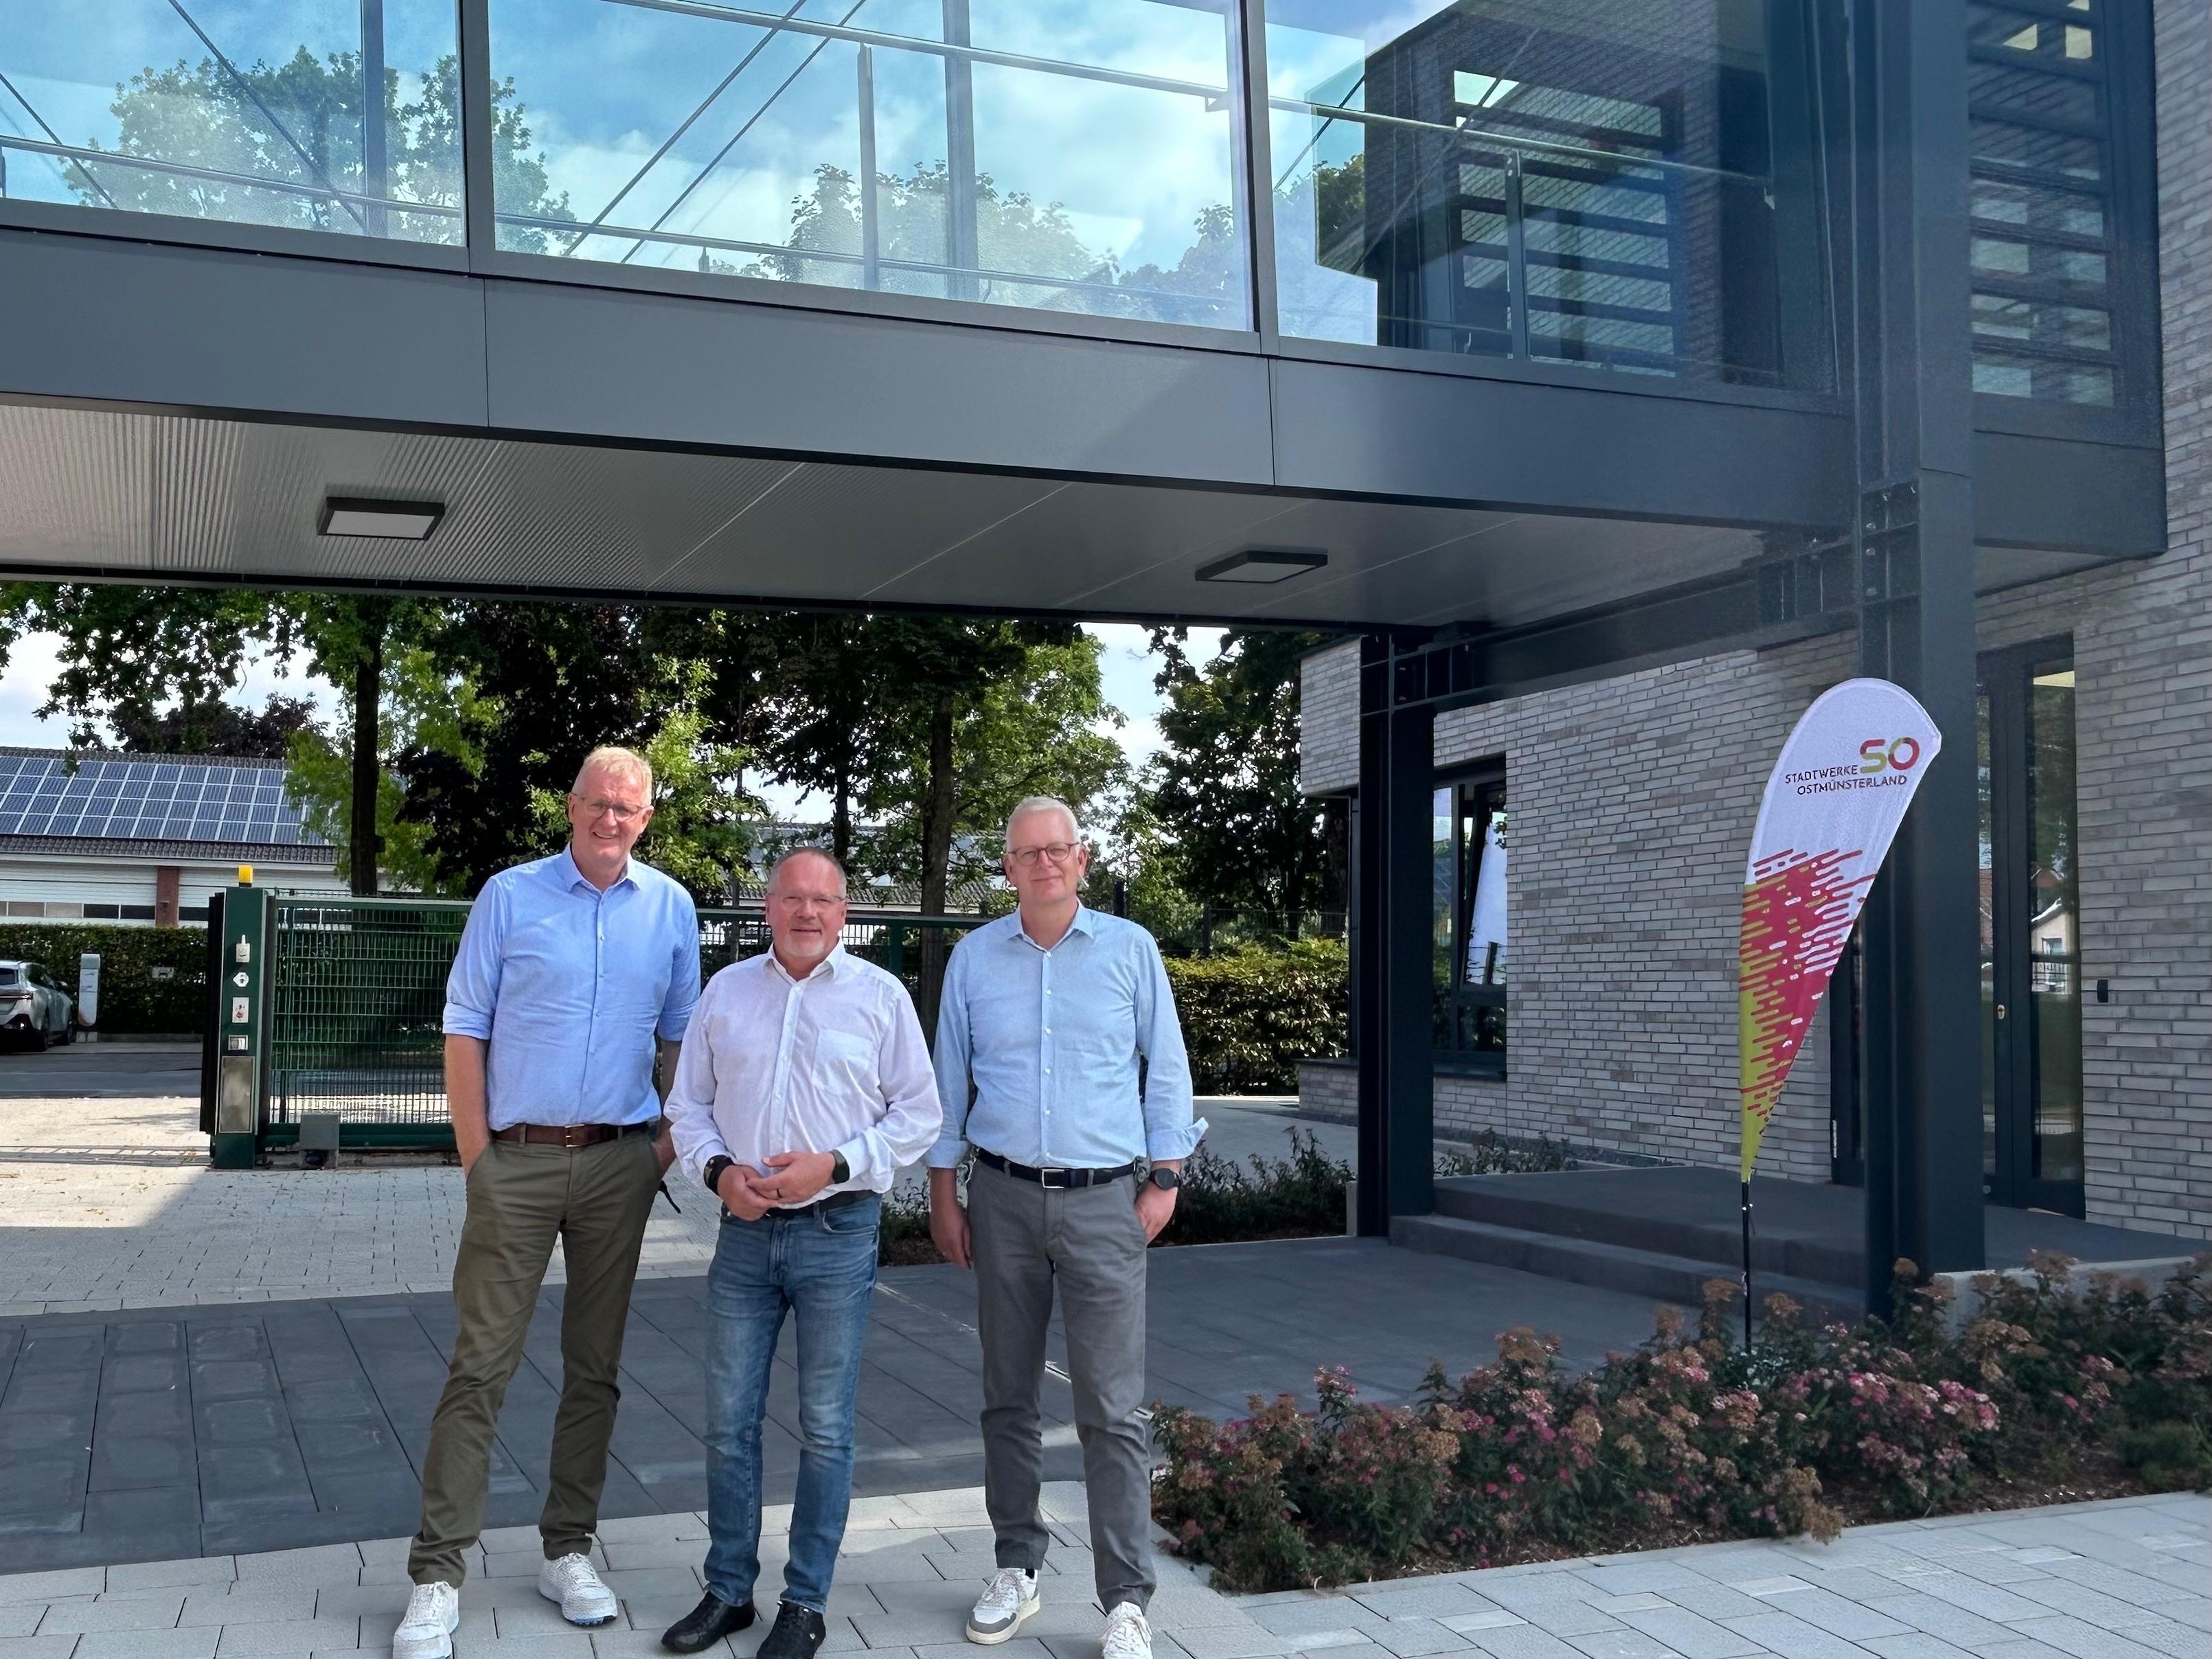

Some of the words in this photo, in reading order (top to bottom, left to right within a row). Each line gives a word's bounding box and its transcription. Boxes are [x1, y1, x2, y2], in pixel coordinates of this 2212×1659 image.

[1860, 737, 1919, 773] SO
[1786, 766, 1858, 783] STADTWERKE
[1797, 775, 1907, 795] OSTMÜNSTERLAND
